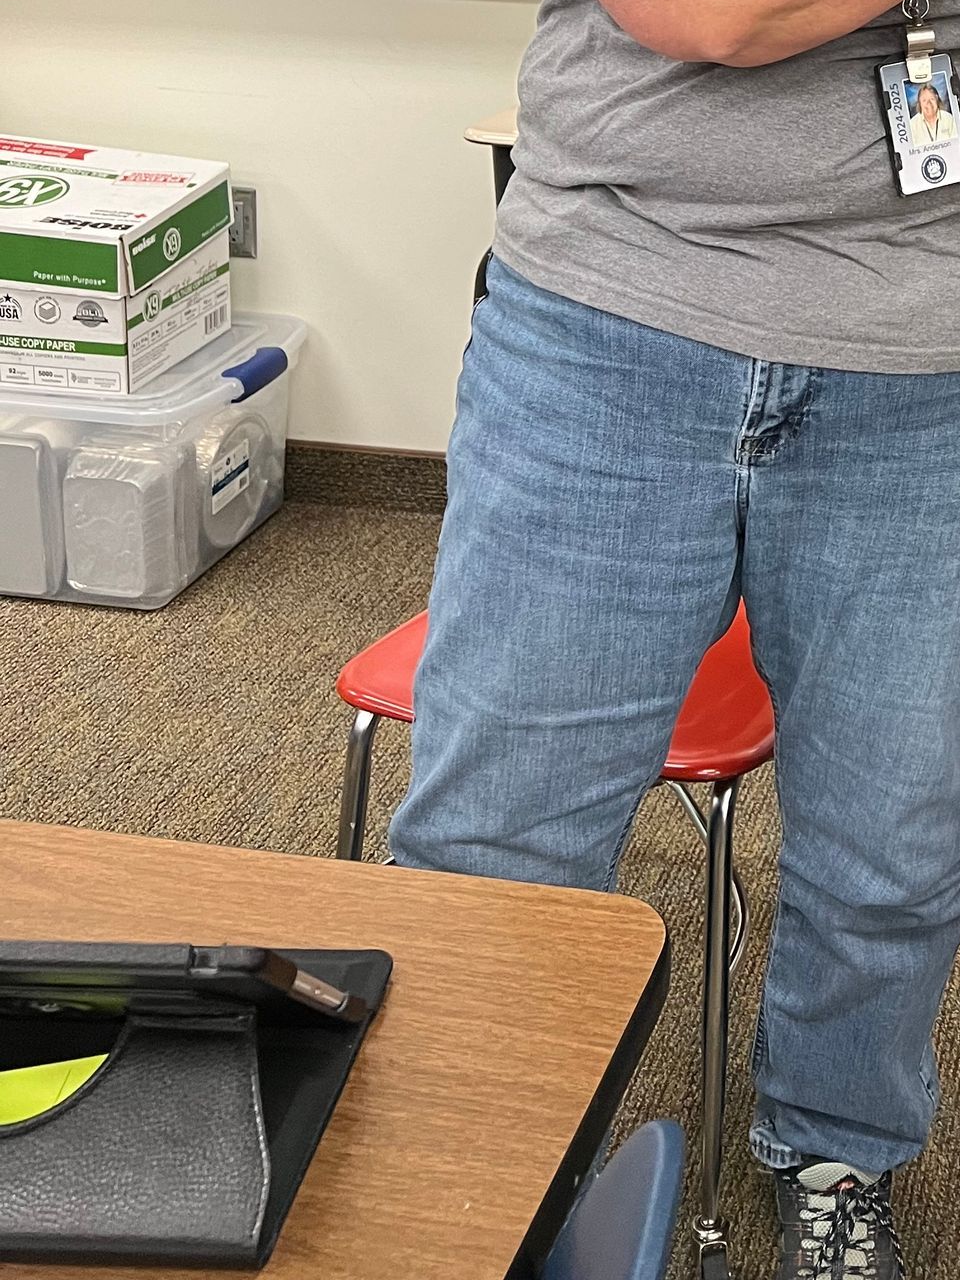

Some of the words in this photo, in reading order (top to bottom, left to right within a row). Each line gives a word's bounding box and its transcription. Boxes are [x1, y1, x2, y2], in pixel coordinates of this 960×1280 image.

[889, 82, 909, 144] 2024-2025
[922, 141, 952, 153] Anderson
[33, 270, 54, 281] Paper
[55, 273, 71, 282] with
[0, 306, 19, 320] USA
[21, 338, 46, 350] COPY
[46, 340, 76, 352] PAPER
